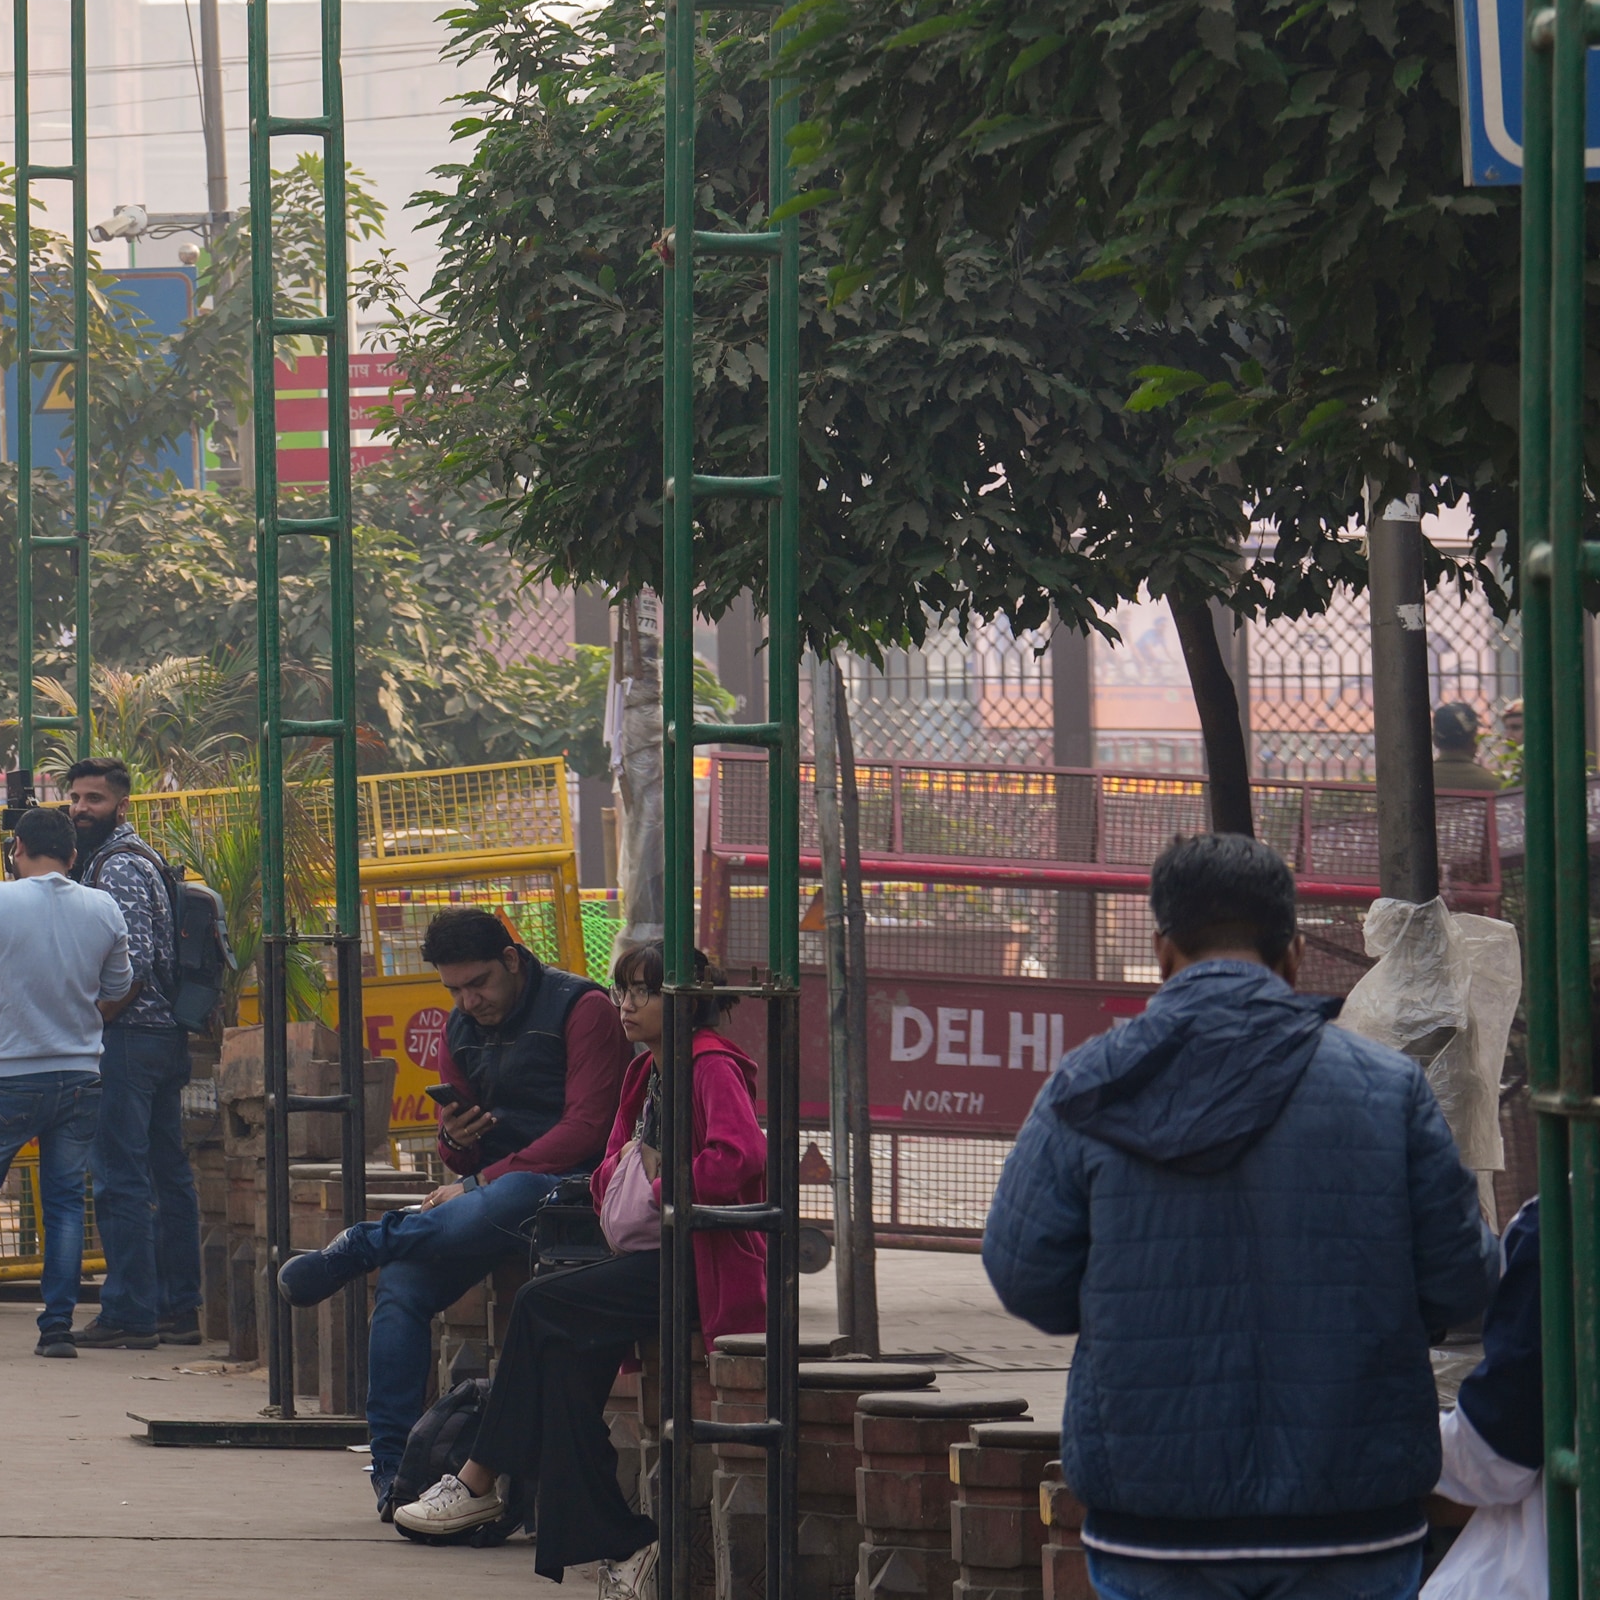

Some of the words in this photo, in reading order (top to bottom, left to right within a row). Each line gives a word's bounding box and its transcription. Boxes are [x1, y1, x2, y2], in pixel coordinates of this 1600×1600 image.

[418, 1009, 444, 1027] ND
[889, 1005, 1064, 1072] DELHI
[902, 1088, 984, 1116] NORTH
